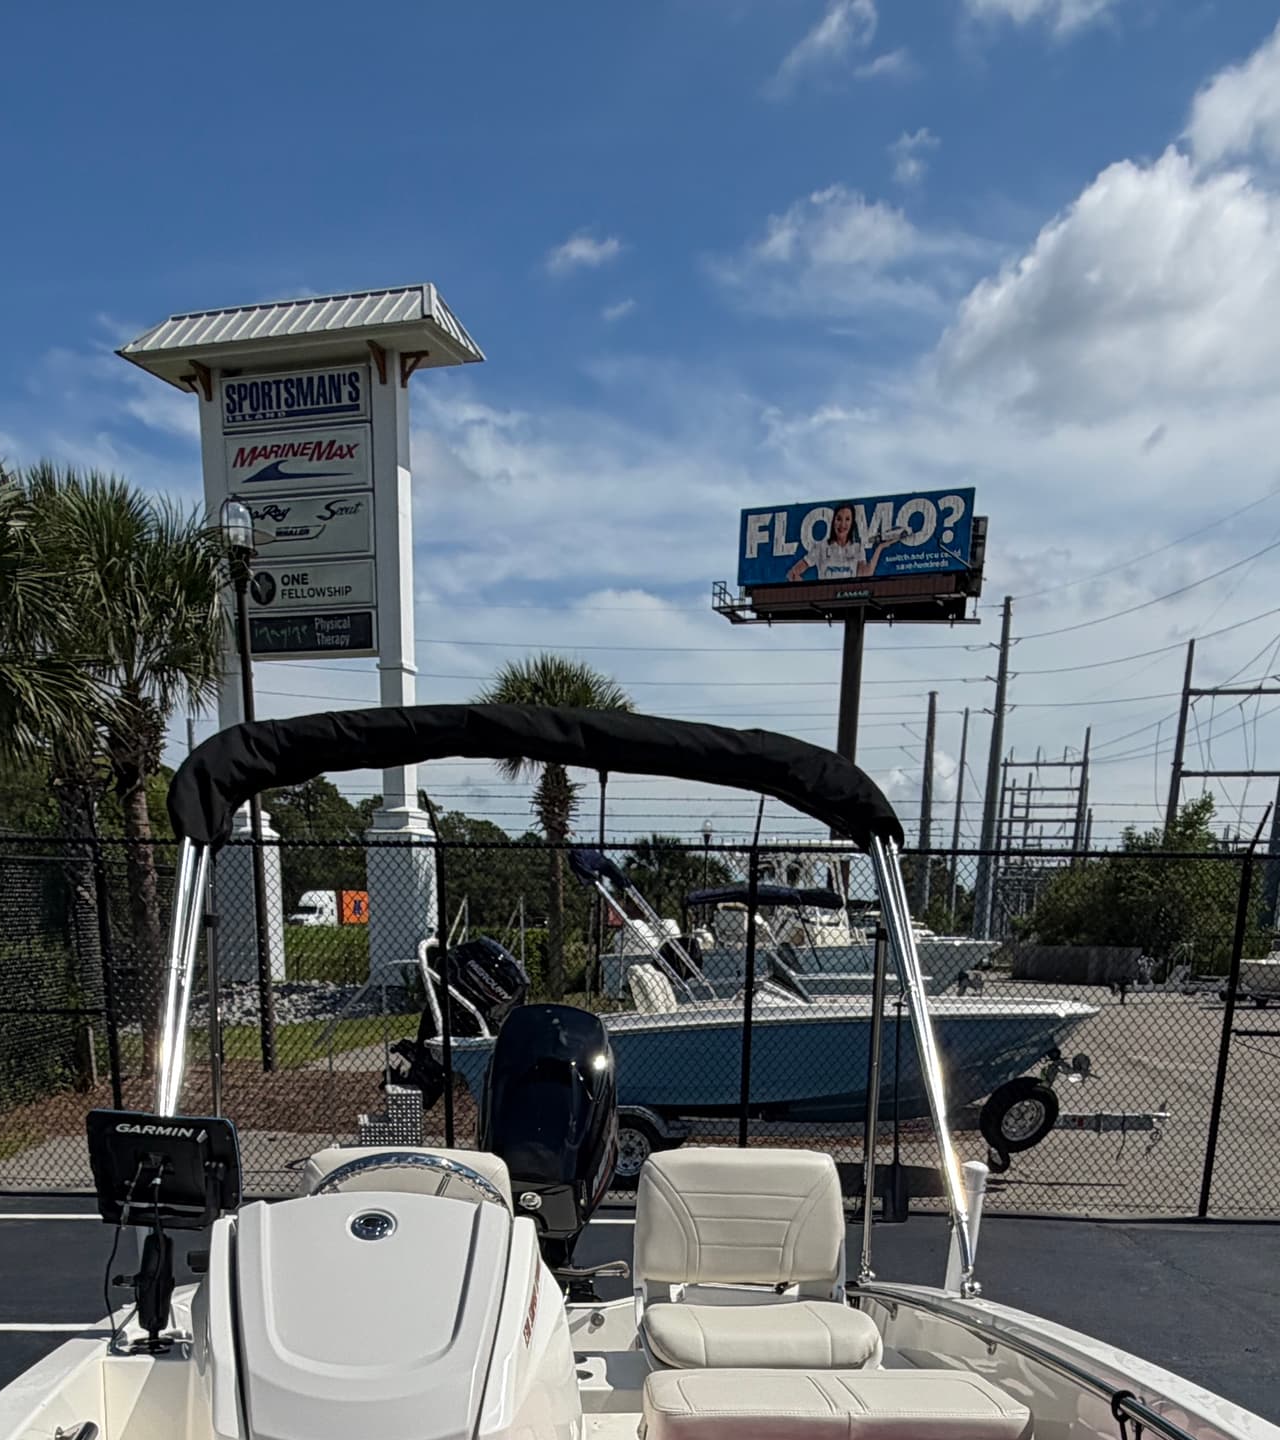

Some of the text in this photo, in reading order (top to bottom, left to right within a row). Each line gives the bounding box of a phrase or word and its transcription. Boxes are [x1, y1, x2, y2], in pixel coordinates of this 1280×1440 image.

[225, 372, 360, 414] SPORTSMAN'S
[281, 573, 309, 585] ONE
[281, 586, 352, 599] FELLOWSHIP
[314, 616, 351, 630] Physical
[316, 631, 350, 647] Therapy
[115, 1123, 194, 1138] GARMIN
